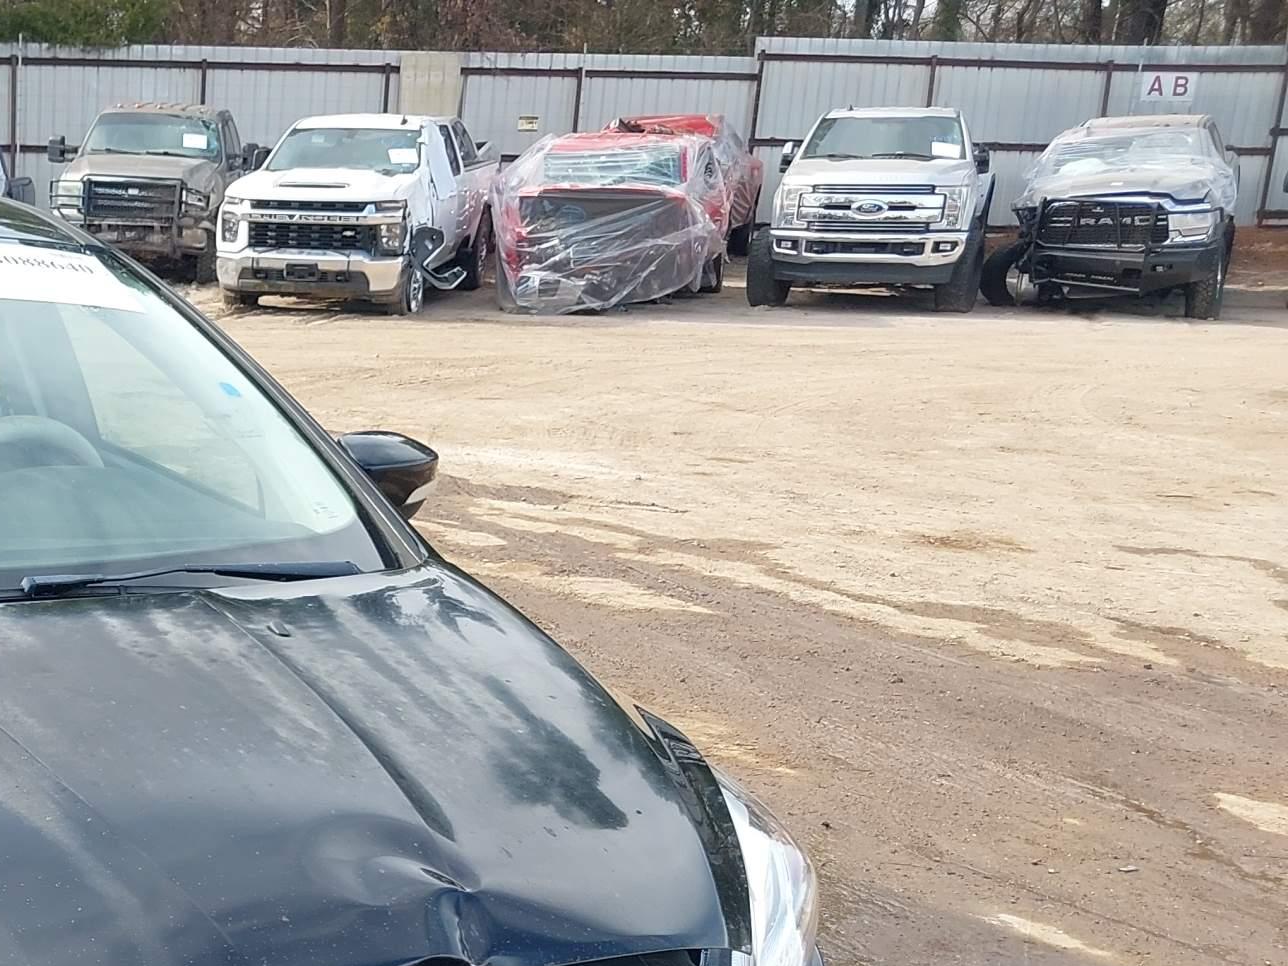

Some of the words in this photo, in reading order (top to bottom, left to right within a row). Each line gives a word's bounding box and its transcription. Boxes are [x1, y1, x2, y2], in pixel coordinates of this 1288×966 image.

[1147, 75, 1163, 96] A
[1172, 76, 1189, 96] B
[1079, 216, 1132, 226] RAM
